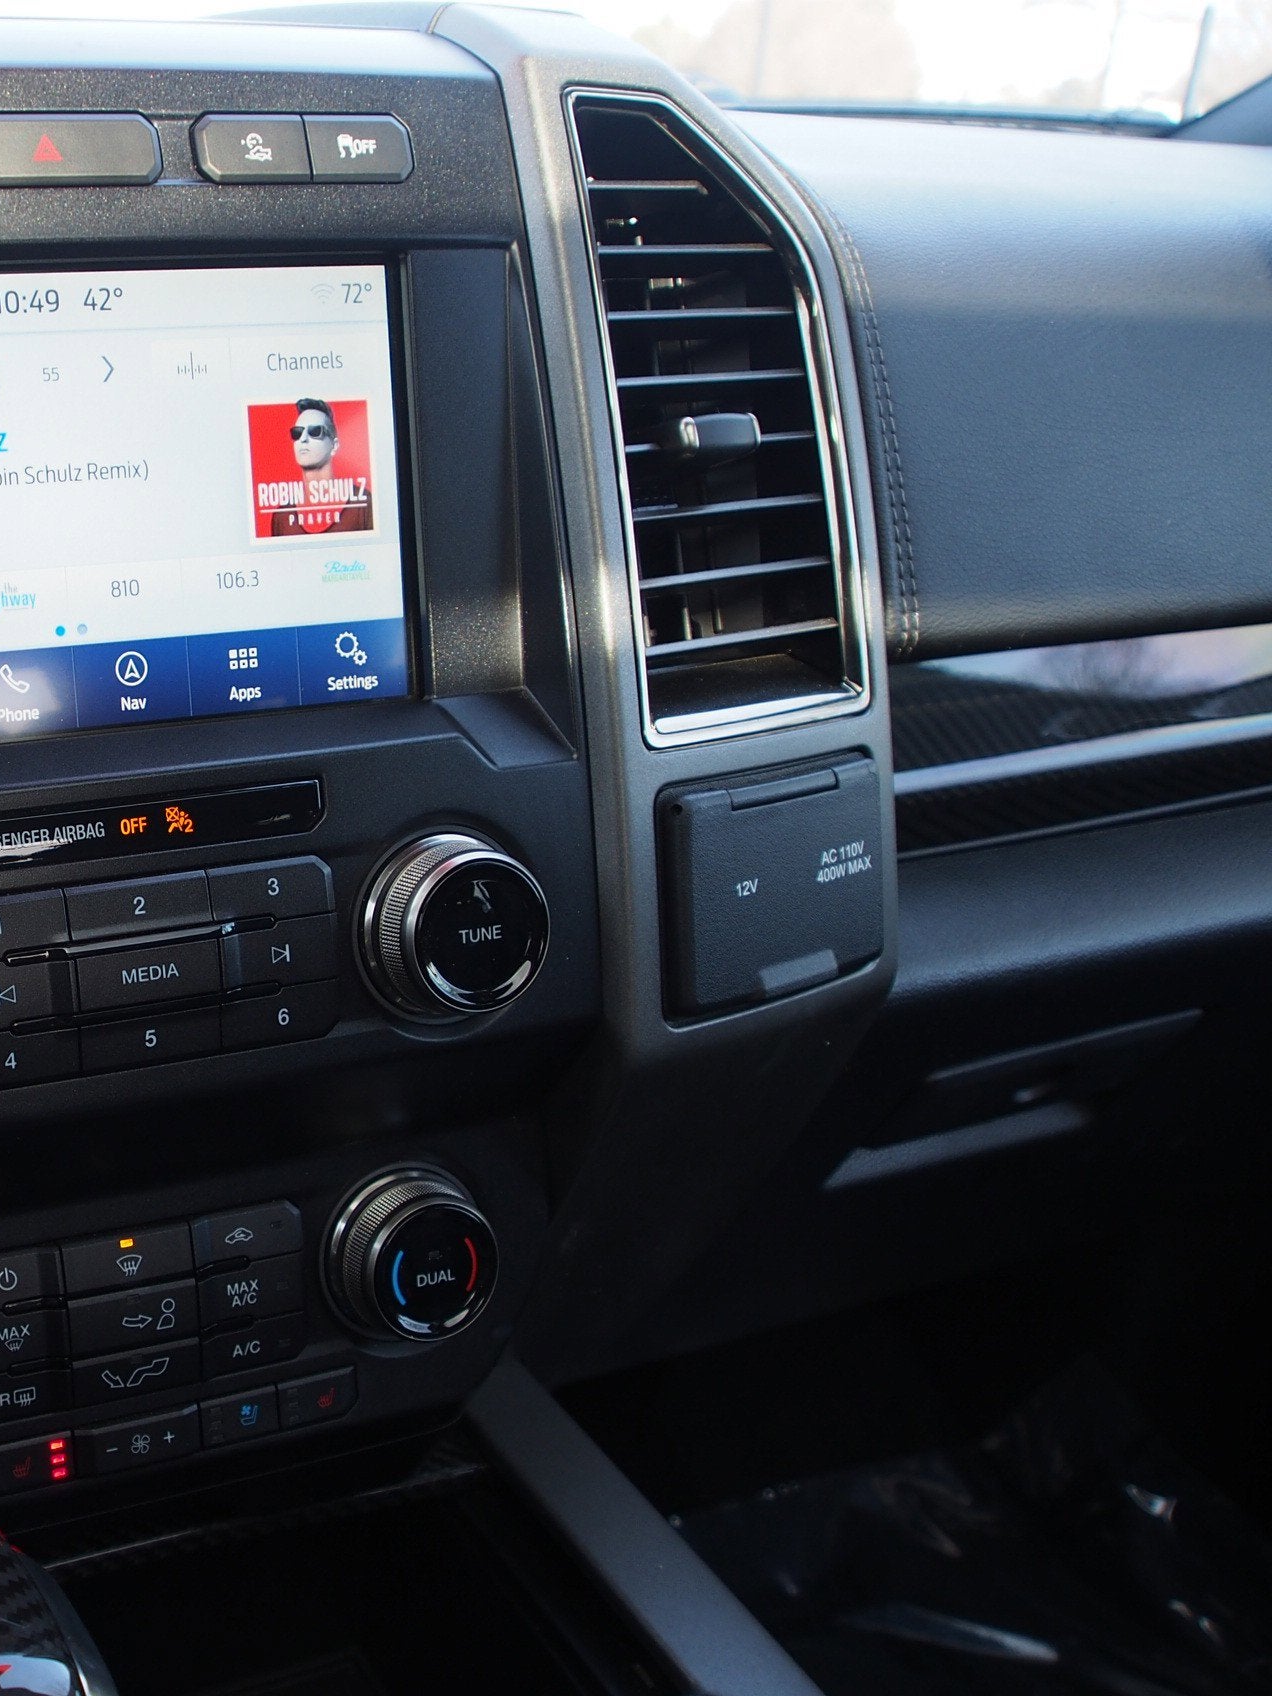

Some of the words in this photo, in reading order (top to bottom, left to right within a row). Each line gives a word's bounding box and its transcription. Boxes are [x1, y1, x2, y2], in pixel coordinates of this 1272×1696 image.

[353, 139, 377, 155] OFF
[83, 286, 124, 313] 42°
[266, 350, 344, 372] Channels
[42, 366, 60, 383] 55
[24, 461, 82, 485] Schulz
[87, 460, 149, 483] Remix)
[257, 480, 304, 507] ROBIN
[308, 476, 368, 504] SCHULZ
[288, 512, 342, 527] PRAYER
[3, 582, 19, 595] the
[111, 579, 140, 598] 810
[216, 569, 260, 590] 106.3
[327, 673, 379, 692] Settings
[229, 685, 262, 702] Apps
[120, 695, 147, 712] Nav
[54, 822, 106, 843] AIRBAG
[120, 816, 148, 836] OFF
[820, 848, 838, 866] AC
[839, 840, 865, 859] 110V
[816, 862, 847, 884] 400W
[848, 855, 873, 875] MAX
[266, 877, 280, 896] 3
[736, 878, 759, 897] 12V
[132, 896, 147, 915] 2
[458, 924, 503, 944] TUNE
[121, 962, 180, 985] MEDIA
[277, 1007, 291, 1026] 6
[144, 1029, 158, 1048] 5
[3, 1051, 18, 1070] 4
[416, 1268, 456, 1287] DUAL
[226, 1278, 259, 1297] MAX
[231, 1289, 258, 1307] A/C
[232, 1339, 261, 1359] A/C
[0, 1392, 11, 1407] R
